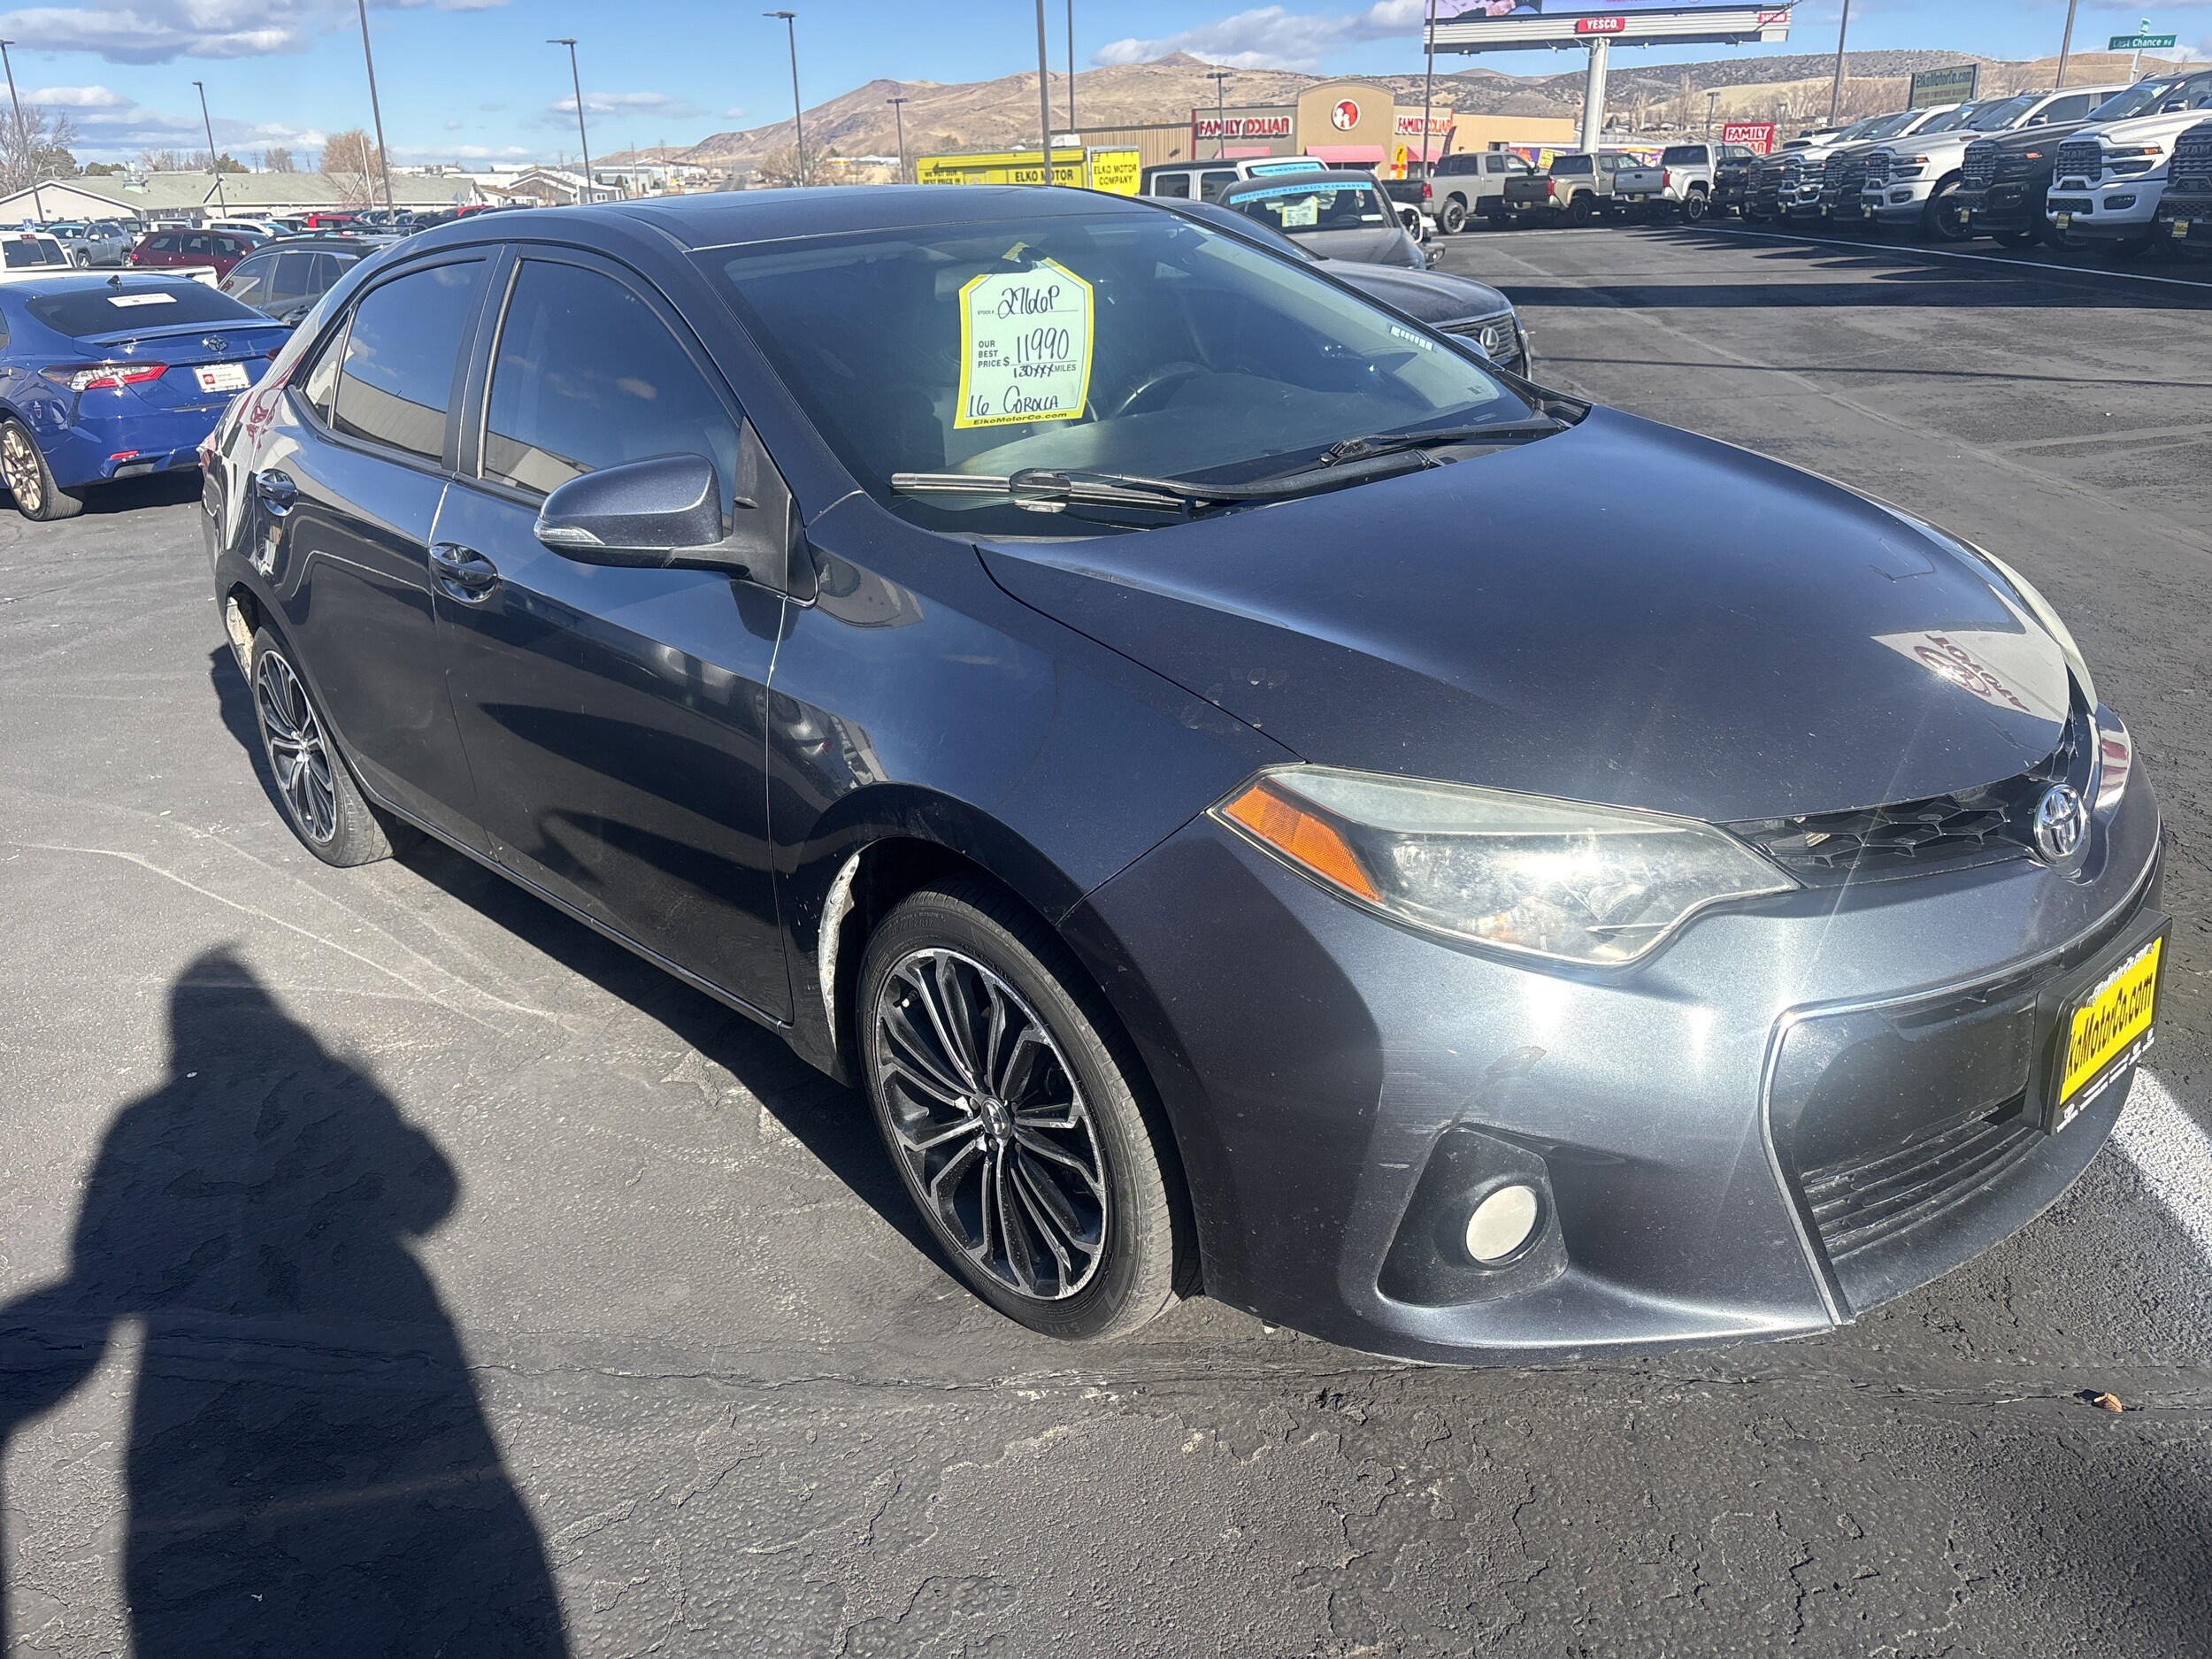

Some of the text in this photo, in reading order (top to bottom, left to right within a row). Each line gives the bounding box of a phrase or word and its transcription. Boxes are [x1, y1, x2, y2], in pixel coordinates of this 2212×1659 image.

[1586, 19, 1617, 30] YESCO
[2112, 39, 2131, 48] Last
[2132, 38, 2161, 47] Chance
[1198, 117, 1292, 135] FAMILY DOLLAR
[1725, 126, 1770, 141] FAMILY
[1015, 170, 1039, 182] ELKO
[978, 340, 995, 349] OUR
[978, 327, 1070, 368] PRICE $ 11990
[1054, 364, 1077, 373] MILES
[969, 395, 989, 417] 16
[972, 411, 1068, 426] ElkoMotorCo.com
[2066, 972, 2154, 1080] koMotorCo.com
